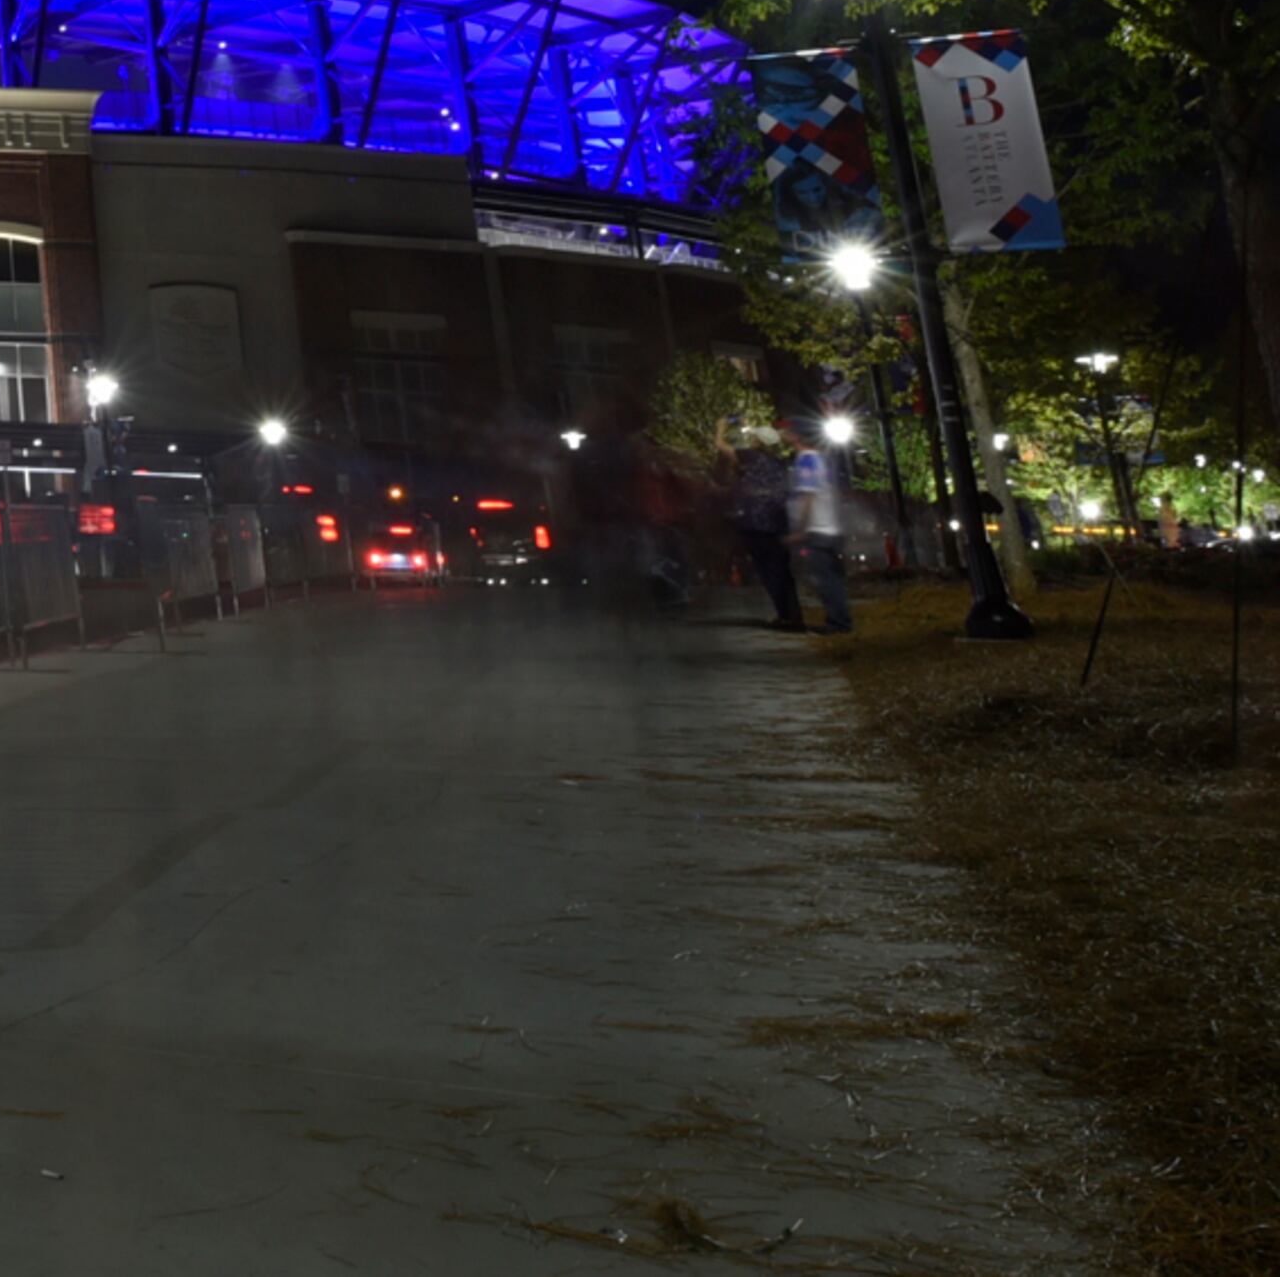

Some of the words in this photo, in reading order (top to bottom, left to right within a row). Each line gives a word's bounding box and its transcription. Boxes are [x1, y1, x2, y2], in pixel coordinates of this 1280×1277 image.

[947, 75, 1004, 127] B
[962, 135, 987, 207] ATLANTA
[978, 132, 1004, 203] BATTERY
[994, 131, 1011, 160] THE
